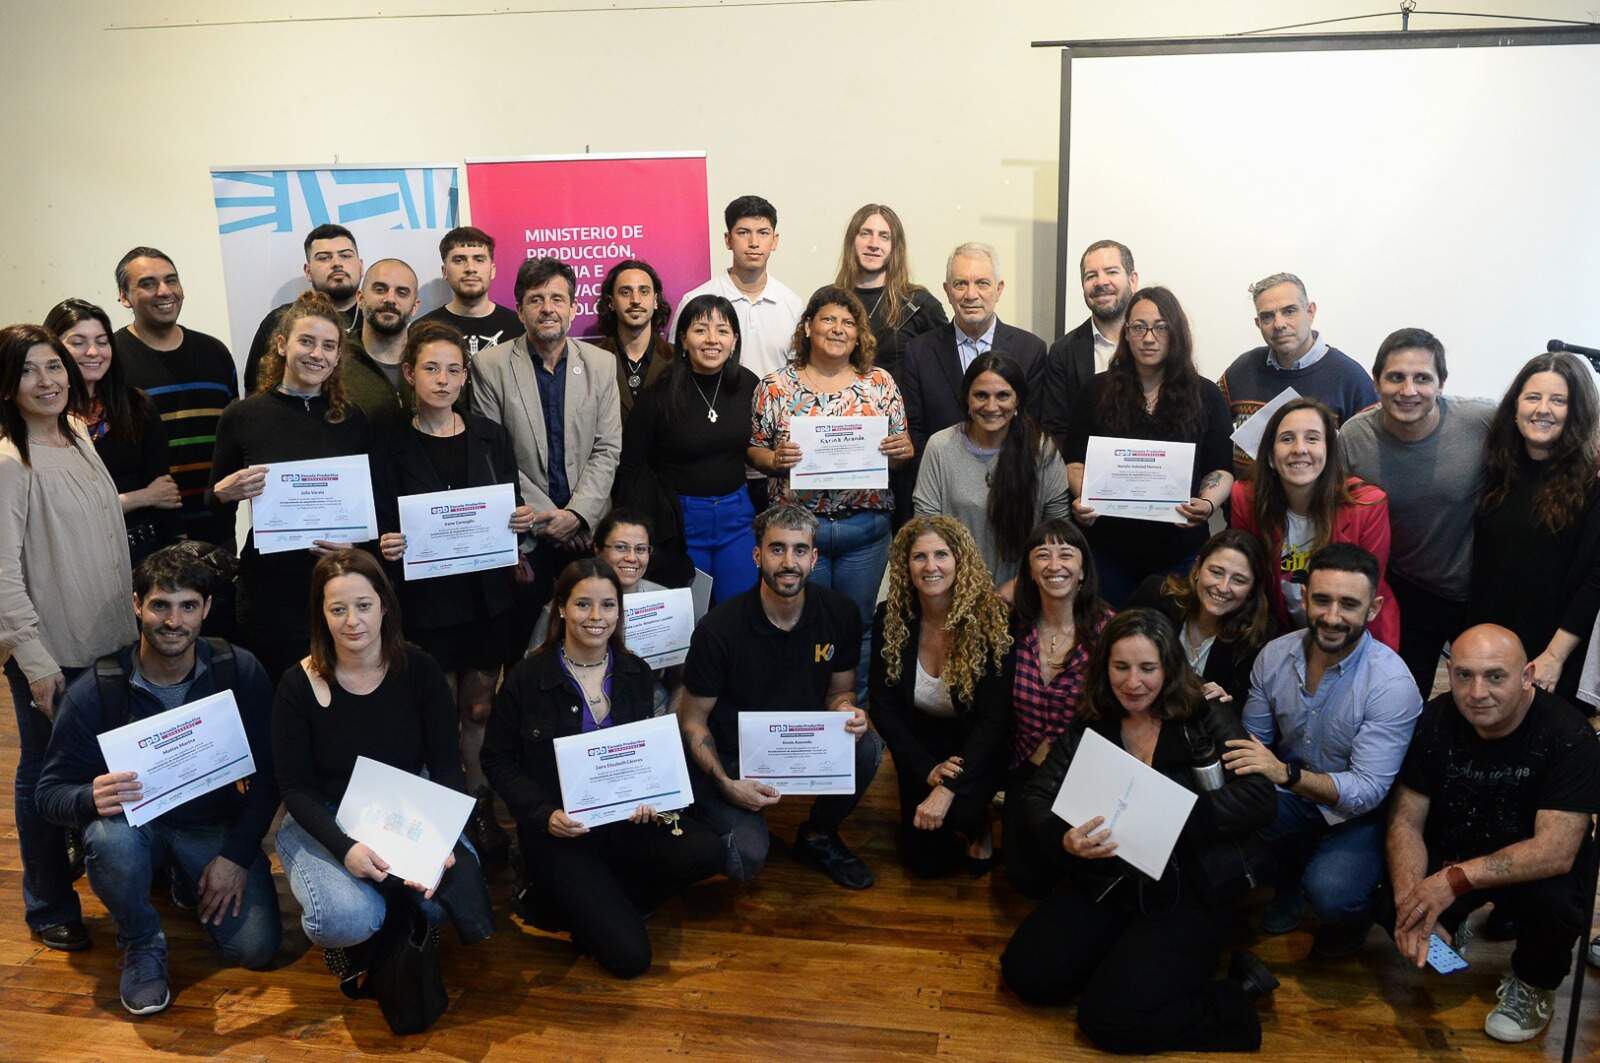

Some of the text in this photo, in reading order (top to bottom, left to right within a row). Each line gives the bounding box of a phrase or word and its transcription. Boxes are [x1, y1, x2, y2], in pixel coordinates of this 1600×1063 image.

[525, 225, 644, 242] MINISTERIO DE
[526, 242, 636, 260] PRODUCCIÓN,
[594, 264, 604, 277] E
